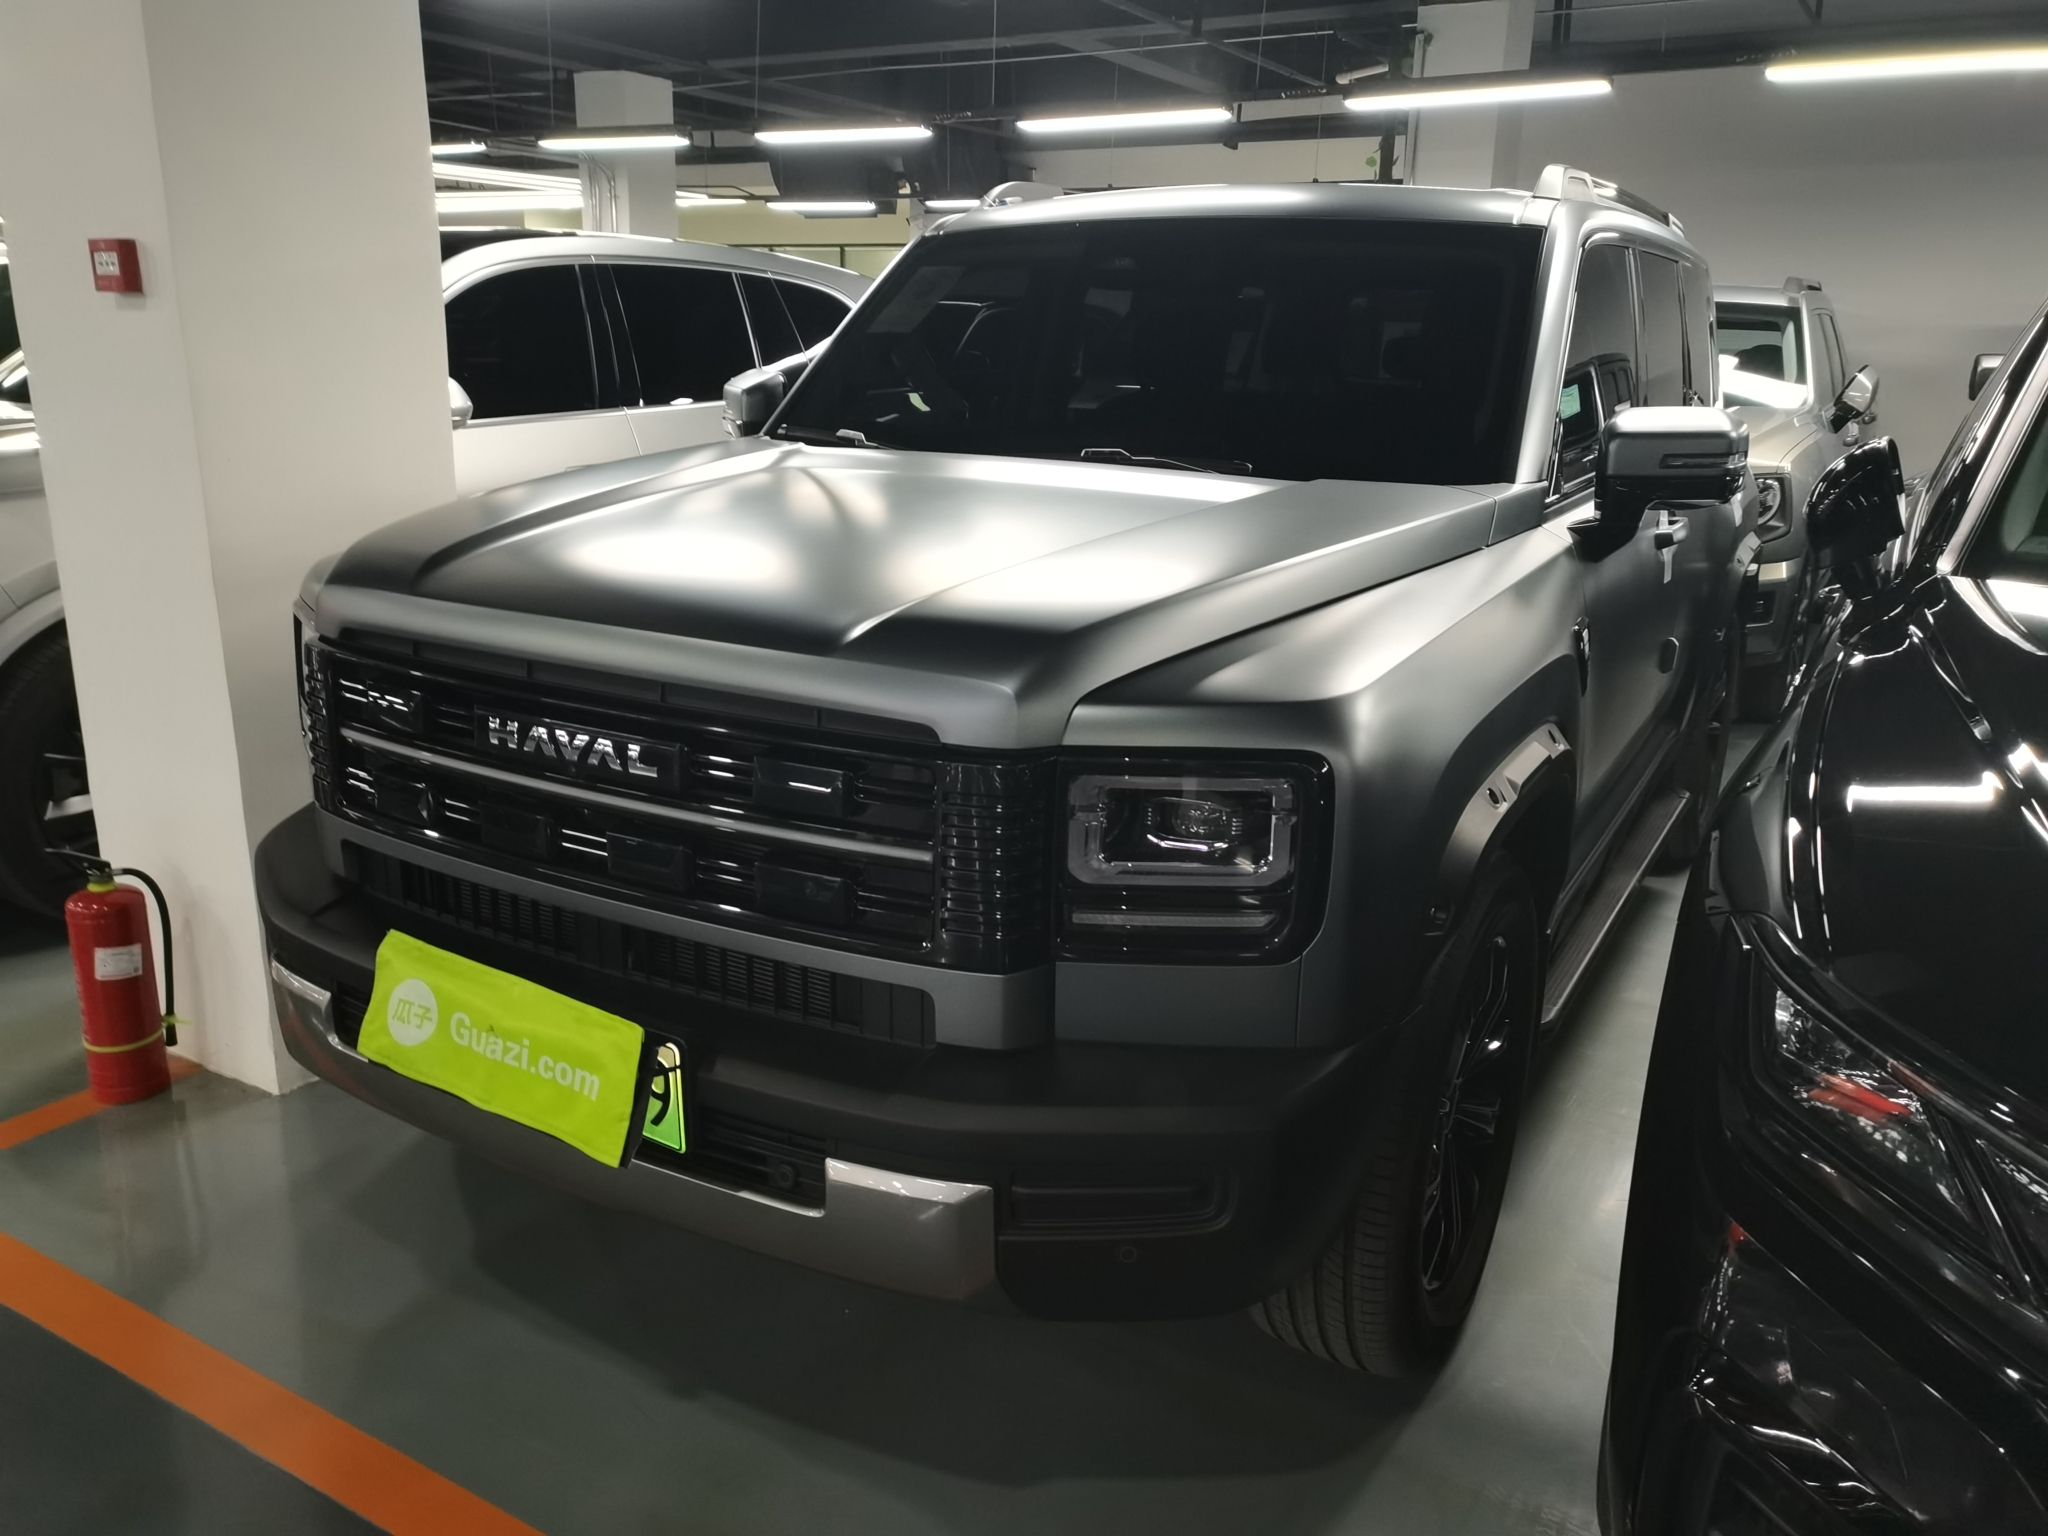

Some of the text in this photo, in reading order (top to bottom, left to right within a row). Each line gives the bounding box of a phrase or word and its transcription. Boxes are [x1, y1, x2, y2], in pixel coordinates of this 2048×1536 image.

[488, 716, 658, 778] HAVAL
[392, 998, 434, 1031] 瓜子
[450, 1012, 601, 1102] Guazi.com
